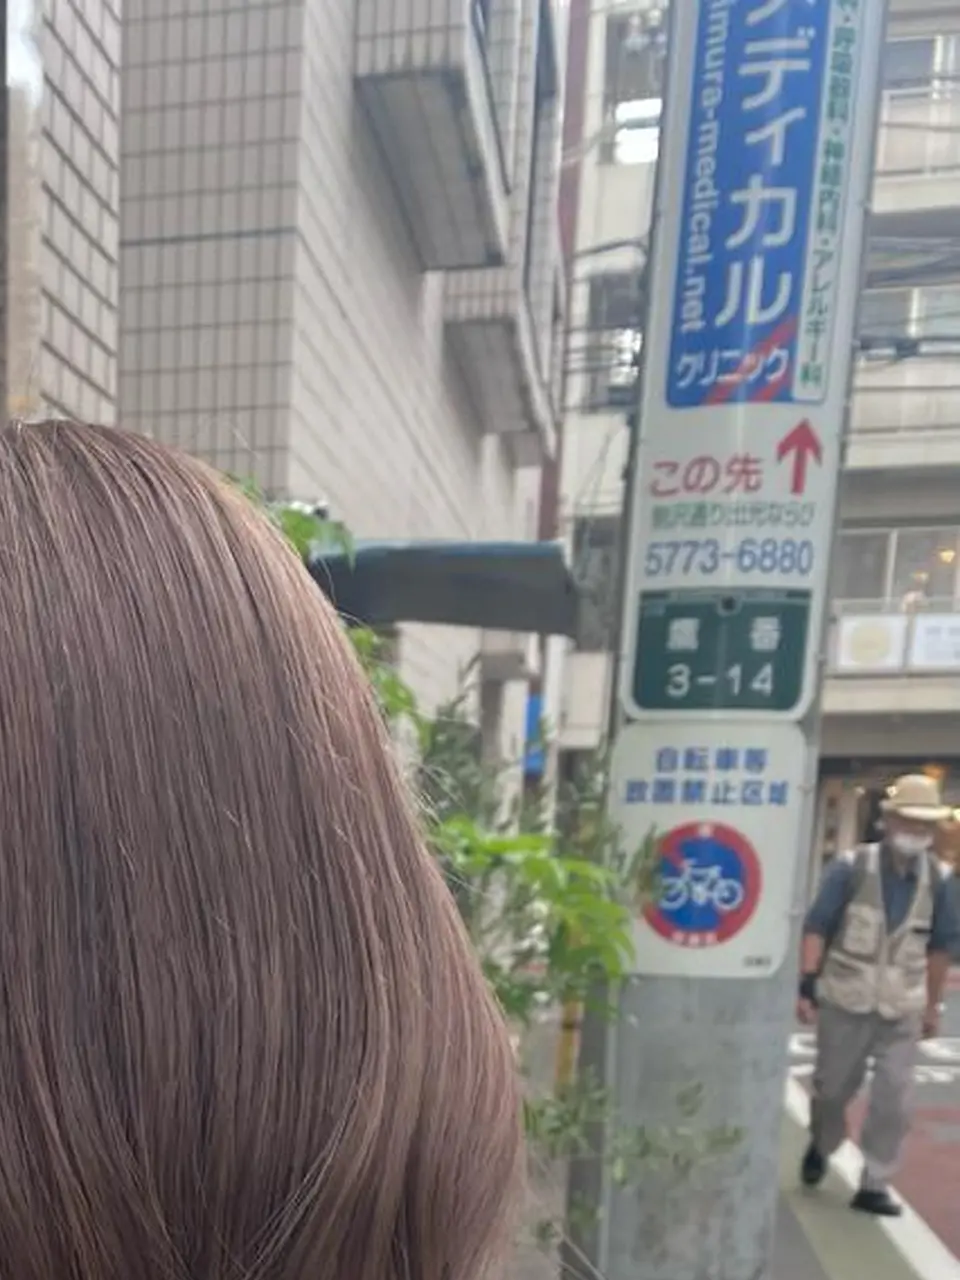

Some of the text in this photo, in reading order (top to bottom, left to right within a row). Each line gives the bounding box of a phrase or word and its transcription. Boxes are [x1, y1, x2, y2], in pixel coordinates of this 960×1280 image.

[676, 346, 790, 388] クリニック
[649, 453, 764, 497] この先
[645, 537, 814, 577] 5773-6880
[667, 664, 773, 697] 3-14
[656, 746, 767, 773] 自転車等
